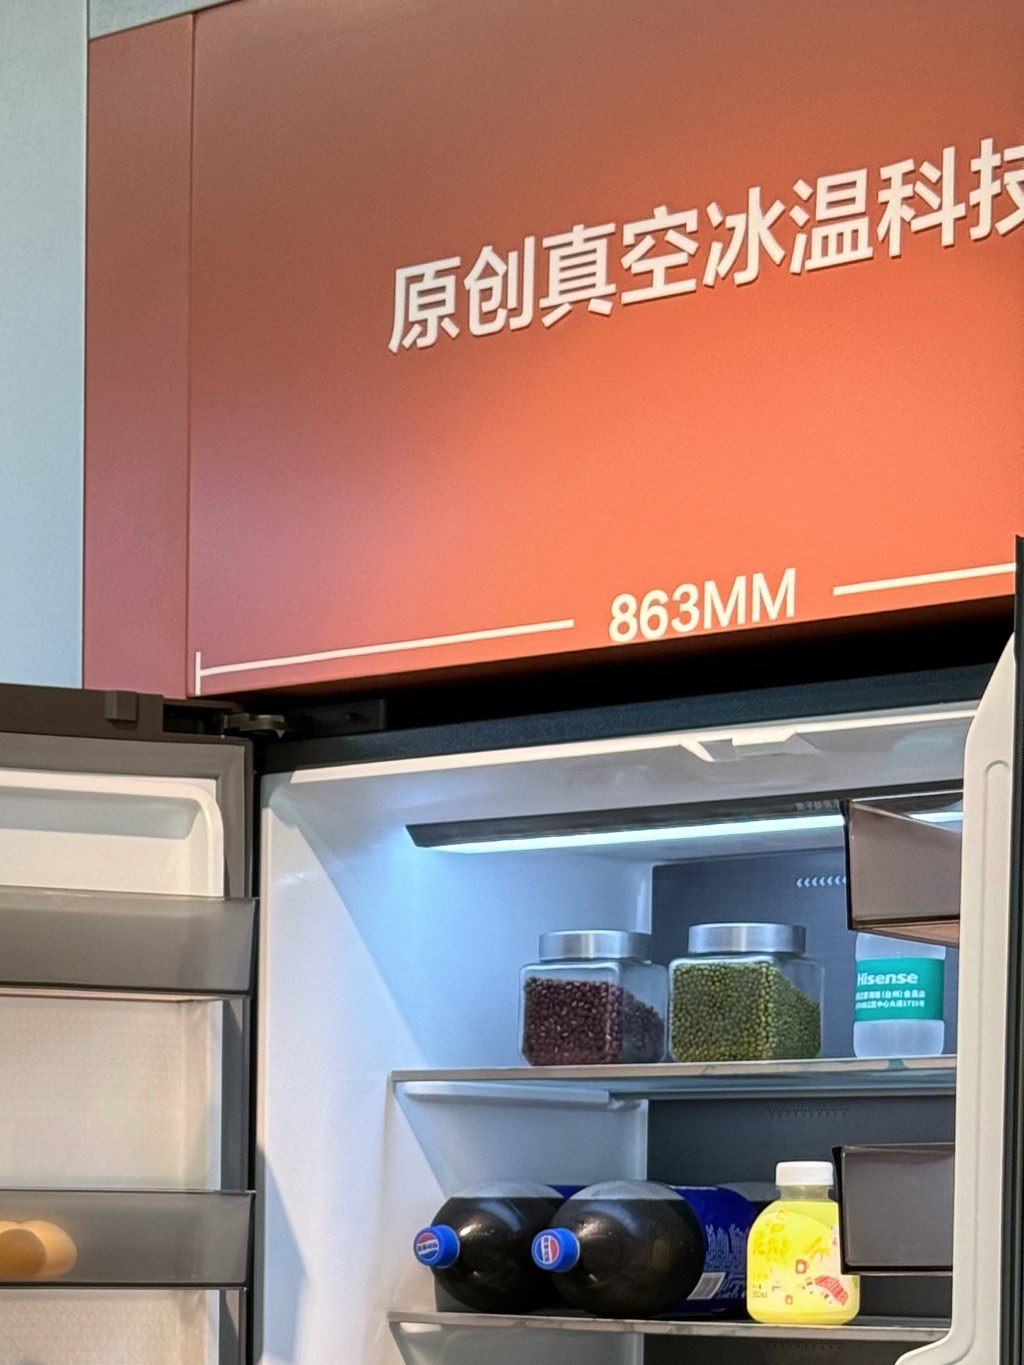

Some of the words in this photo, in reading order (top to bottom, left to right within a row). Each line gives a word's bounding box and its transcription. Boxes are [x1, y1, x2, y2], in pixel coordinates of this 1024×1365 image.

[387, 137, 1024, 353] 原创真空冰温科技
[608, 567, 796, 644] 863MM
[857, 972, 918, 987] Hisense
